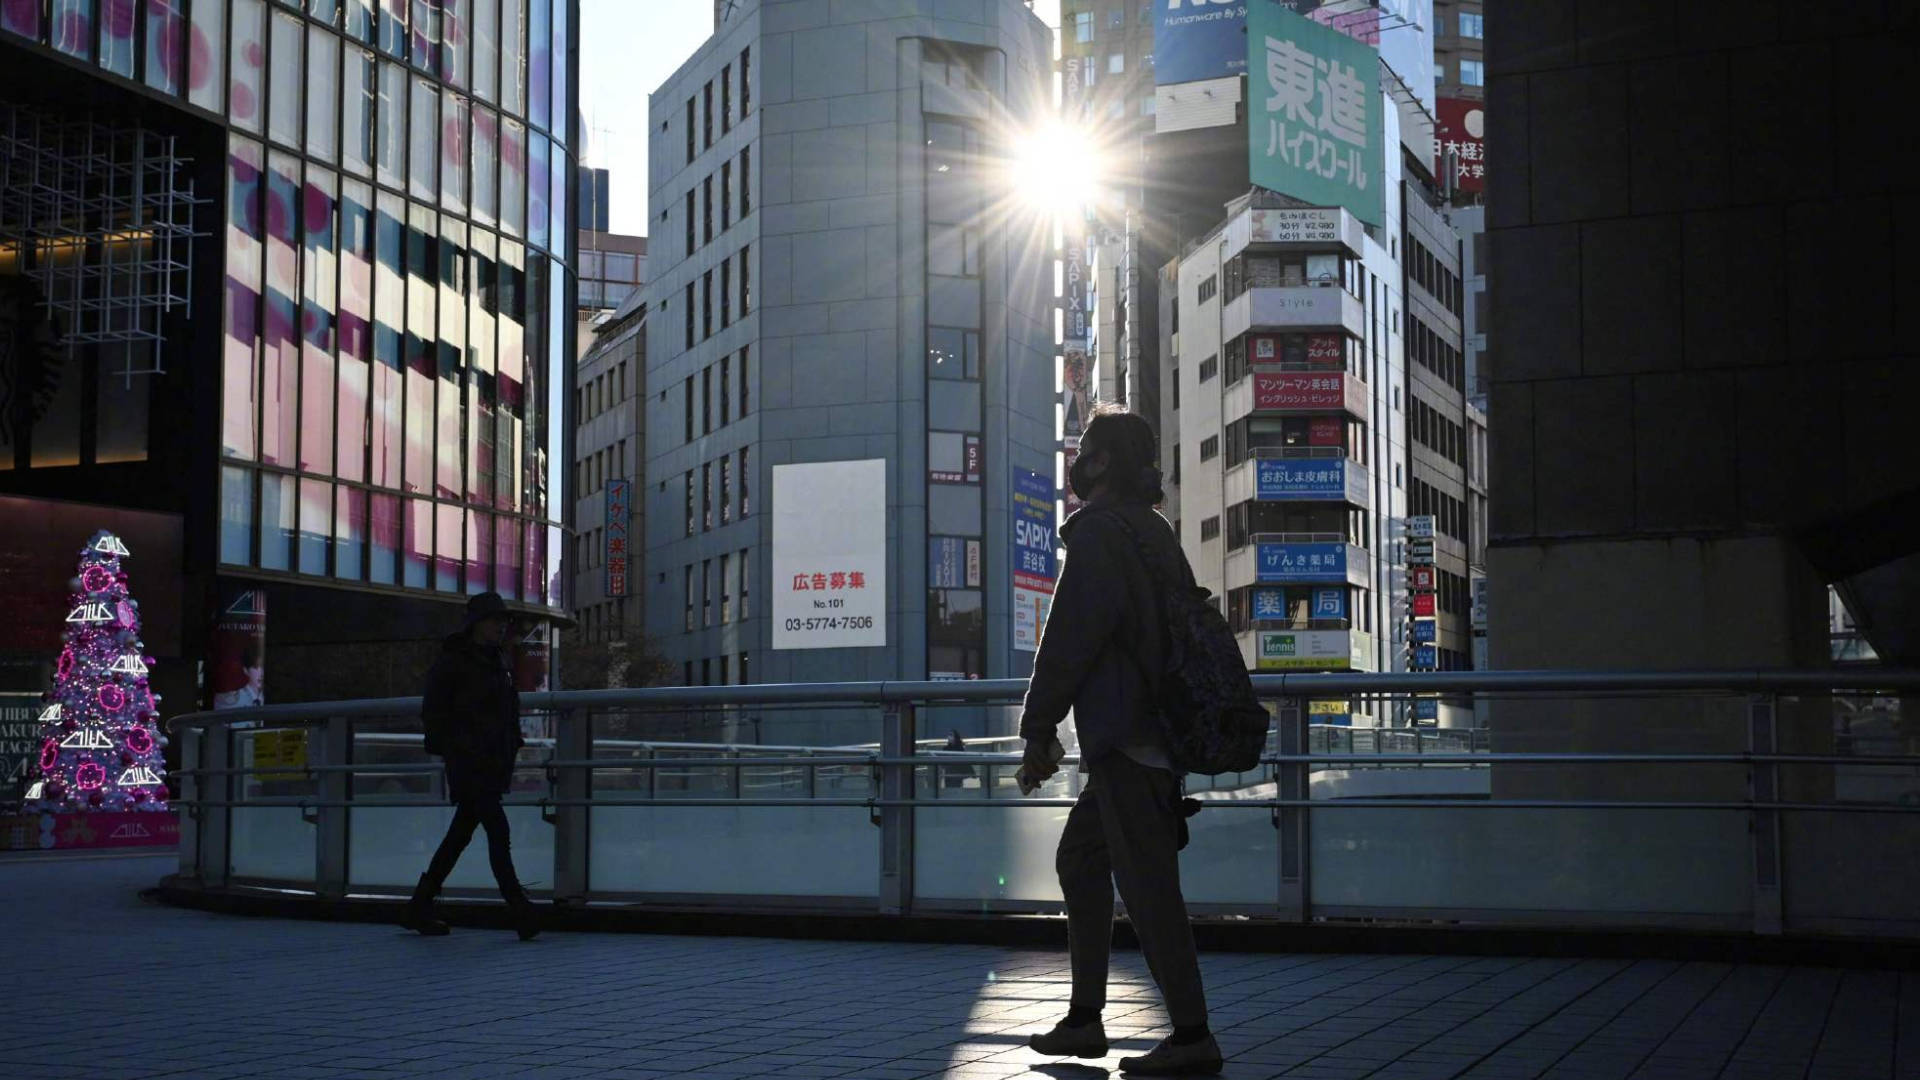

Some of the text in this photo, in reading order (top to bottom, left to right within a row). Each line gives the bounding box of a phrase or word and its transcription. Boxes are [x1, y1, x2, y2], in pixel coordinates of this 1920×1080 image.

[1165, 12, 1223, 25] Humanware
[1224, 8, 1235, 19] By
[1265, 36, 1366, 148] 東進
[1266, 120, 1366, 191] ハイスクール
[1458, 162, 1484, 178] 大学
[1068, 249, 1081, 310] SAPIX
[1308, 348, 1340, 358] スタイル
[1259, 378, 1340, 391] マンツーマン英会話
[1261, 471, 1341, 483] おおしま皮膚科
[1016, 520, 1051, 553] SAPIX
[1023, 551, 1046, 575] 渋谷校
[1267, 554, 1335, 566] げんき薬局
[792, 571, 866, 592] 広告募集
[785, 616, 873, 631] 03-5774-7506
[1264, 636, 1296, 652] Tennis
